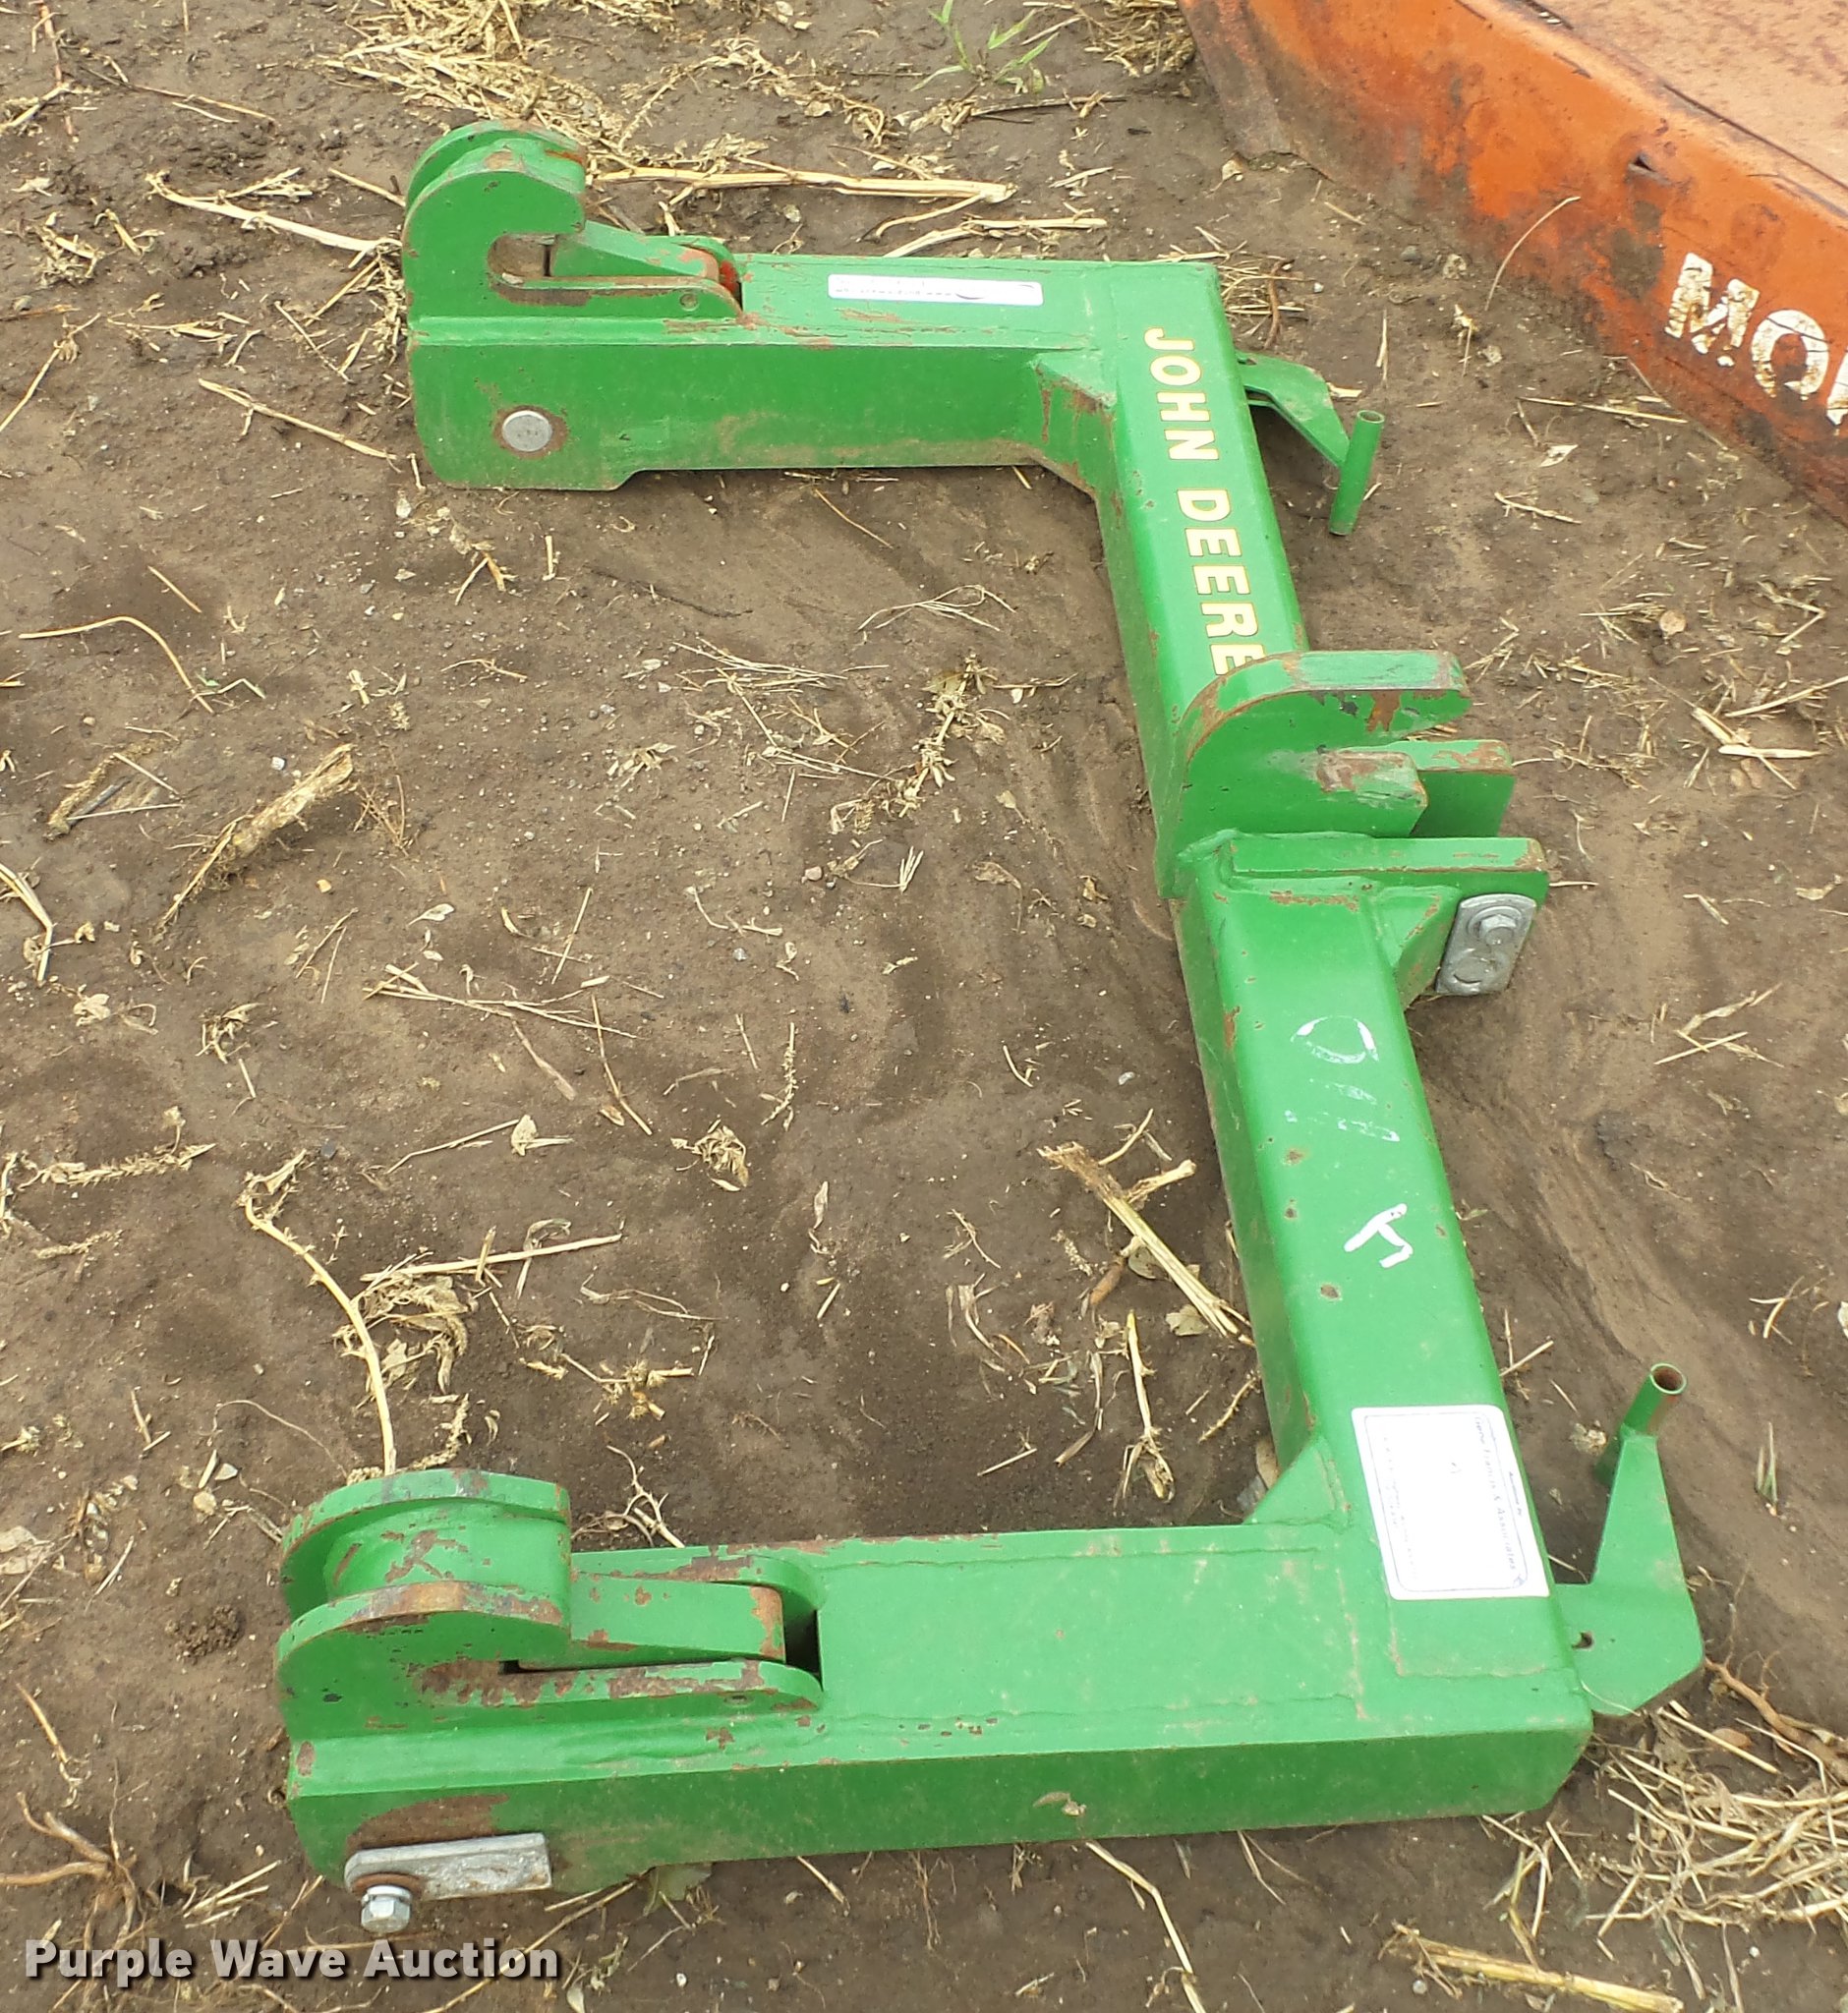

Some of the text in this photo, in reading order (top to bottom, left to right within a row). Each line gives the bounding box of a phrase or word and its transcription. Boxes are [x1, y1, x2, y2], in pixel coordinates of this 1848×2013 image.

[1664, 252, 1848, 427] MO
[1144, 326, 1269, 676] JOHN DEERE
